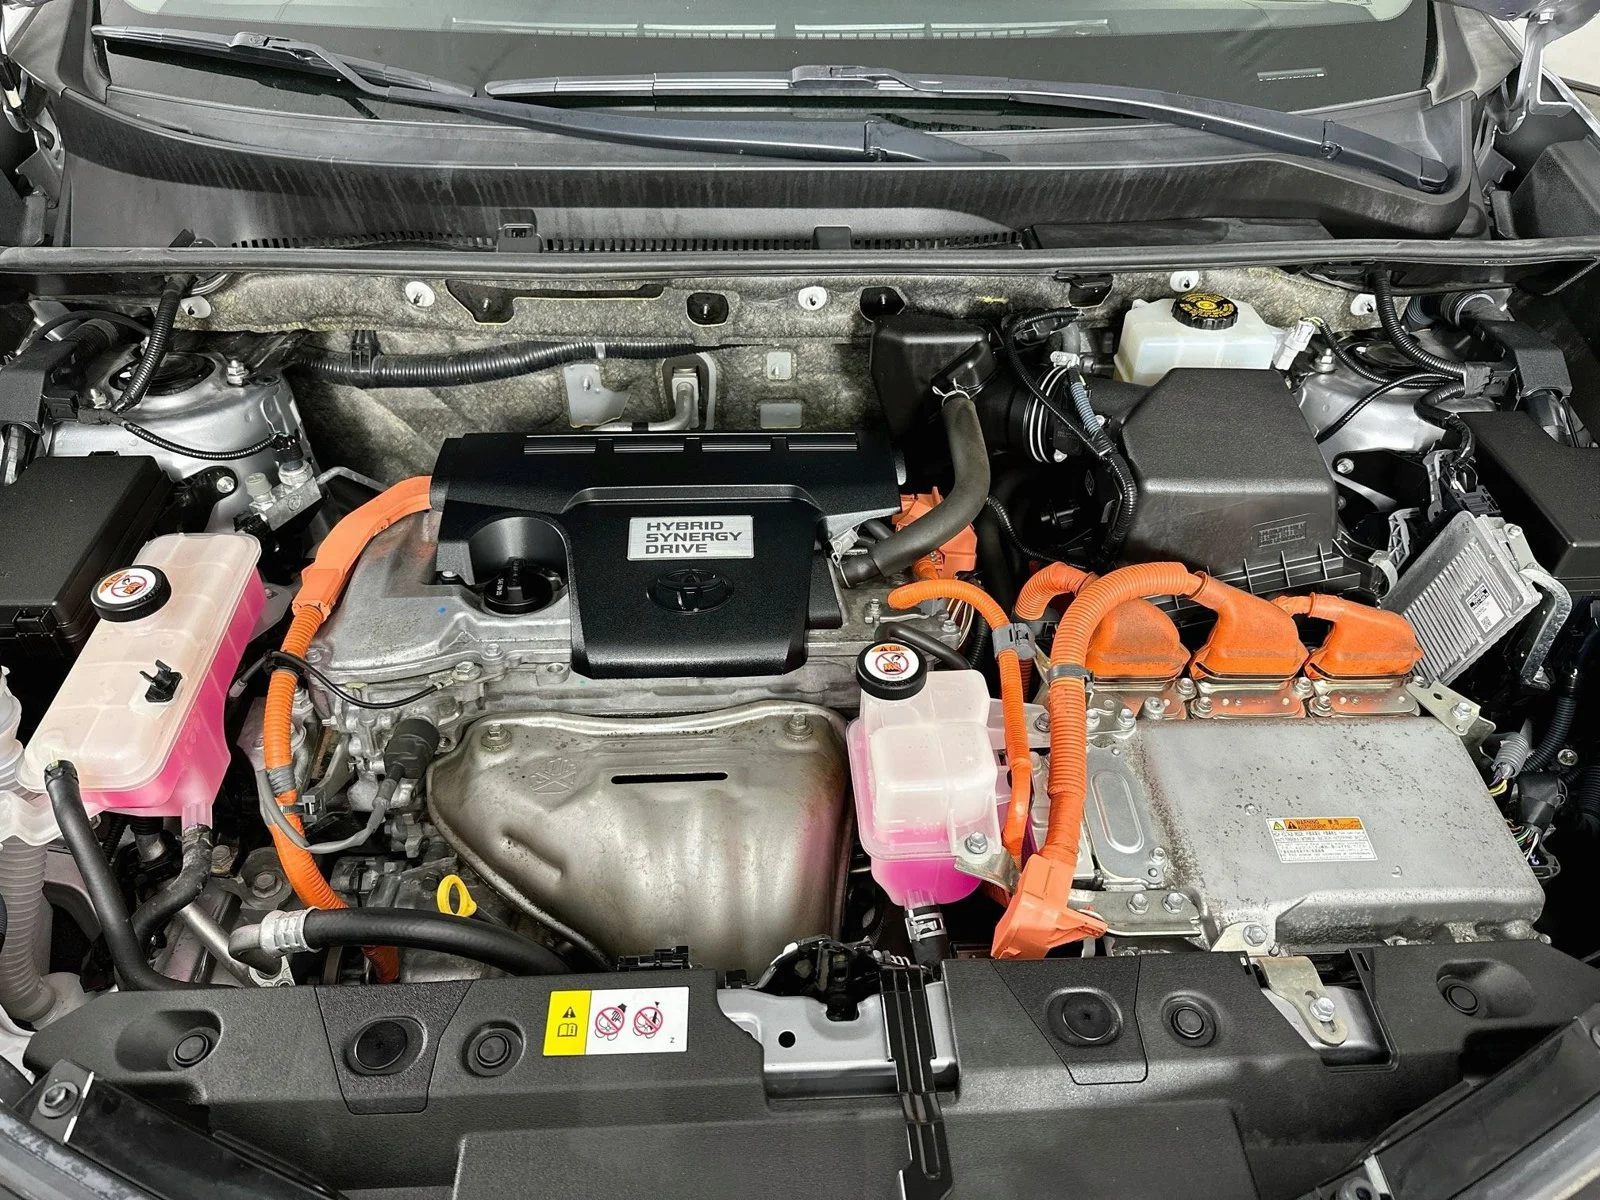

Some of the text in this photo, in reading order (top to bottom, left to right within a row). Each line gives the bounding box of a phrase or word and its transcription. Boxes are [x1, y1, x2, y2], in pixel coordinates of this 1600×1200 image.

[646, 521, 724, 531] HYBRID
[645, 532, 743, 543] SYNERGY
[645, 543, 708, 555] DRIVE
